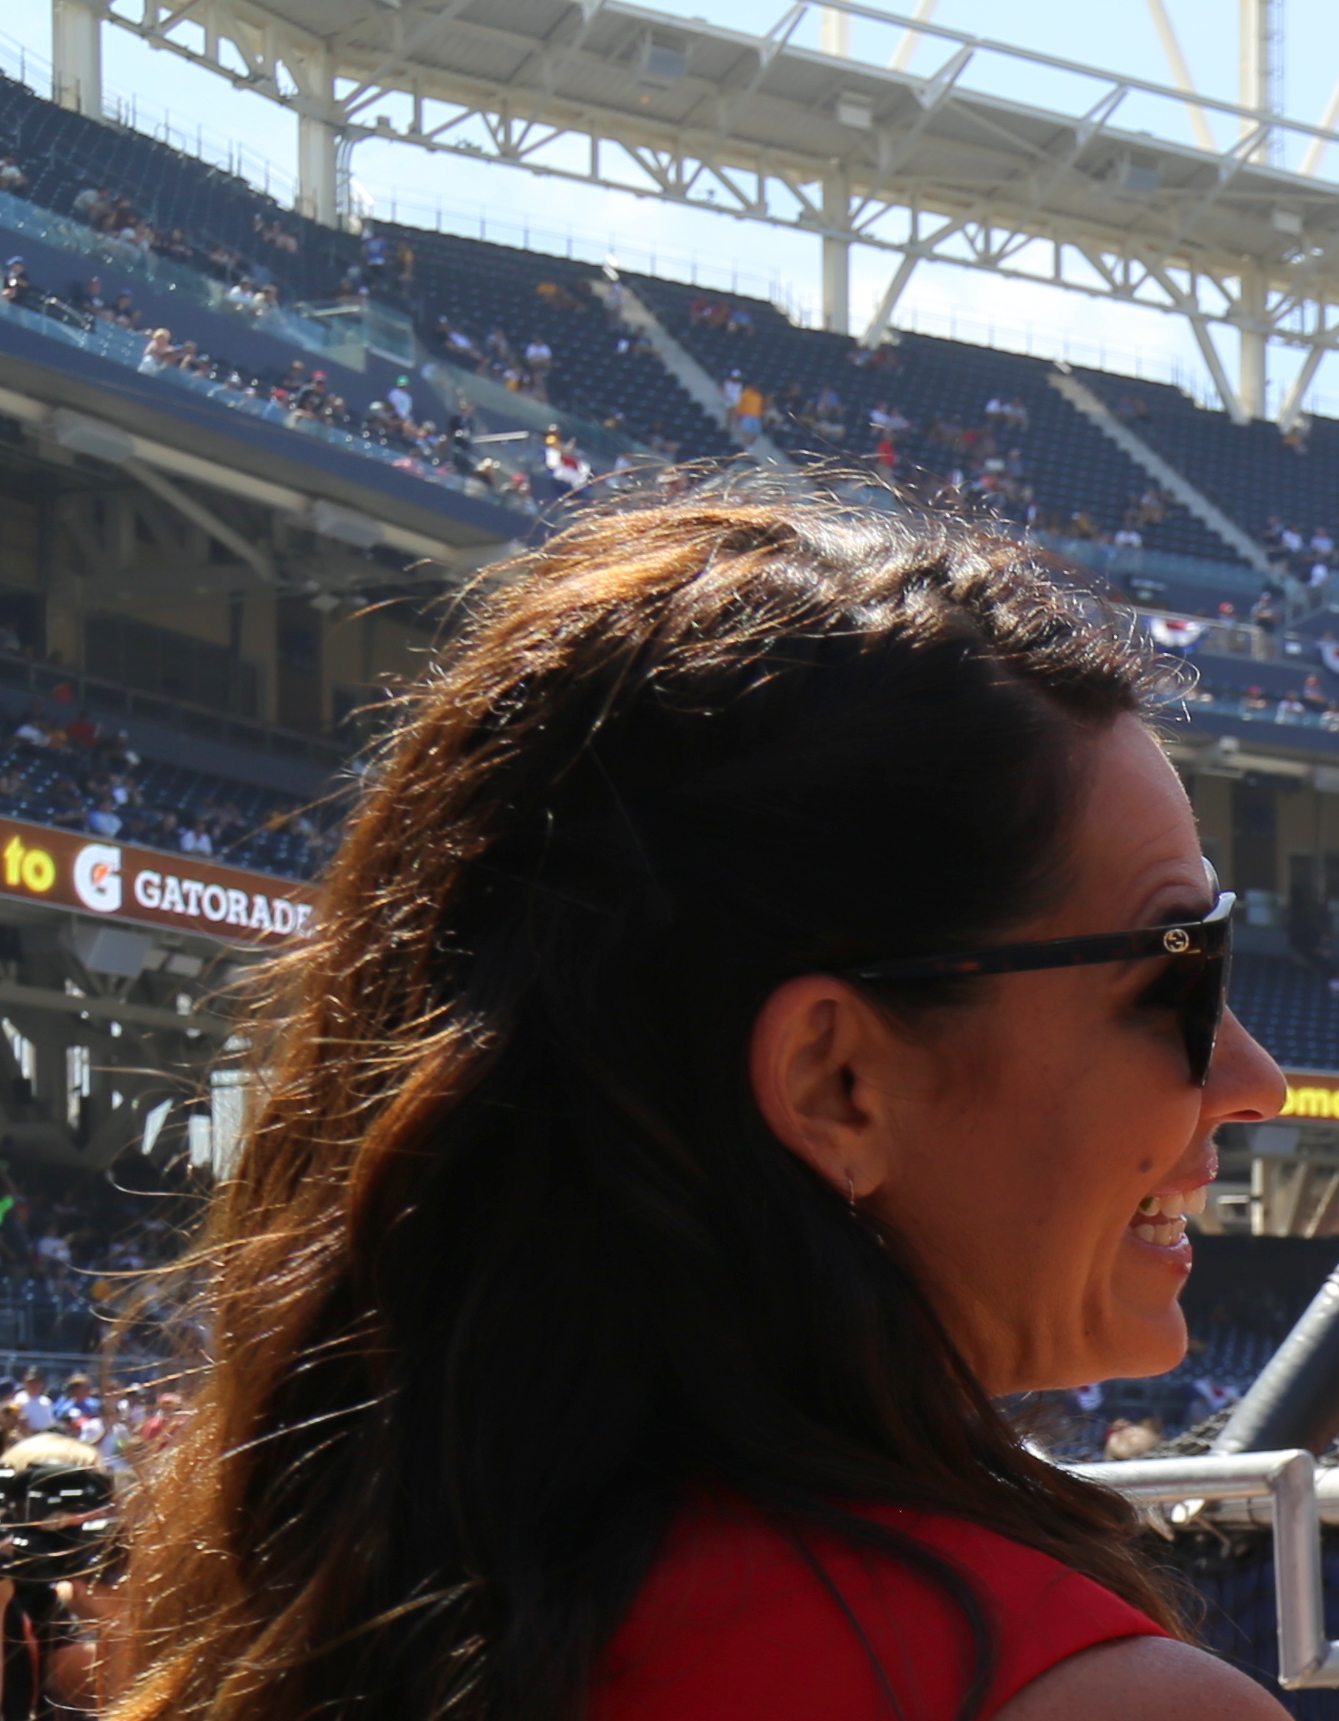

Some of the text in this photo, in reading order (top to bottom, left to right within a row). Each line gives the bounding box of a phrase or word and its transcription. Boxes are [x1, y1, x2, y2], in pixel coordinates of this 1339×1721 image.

[4, 834, 314, 939] to G GATORADE
